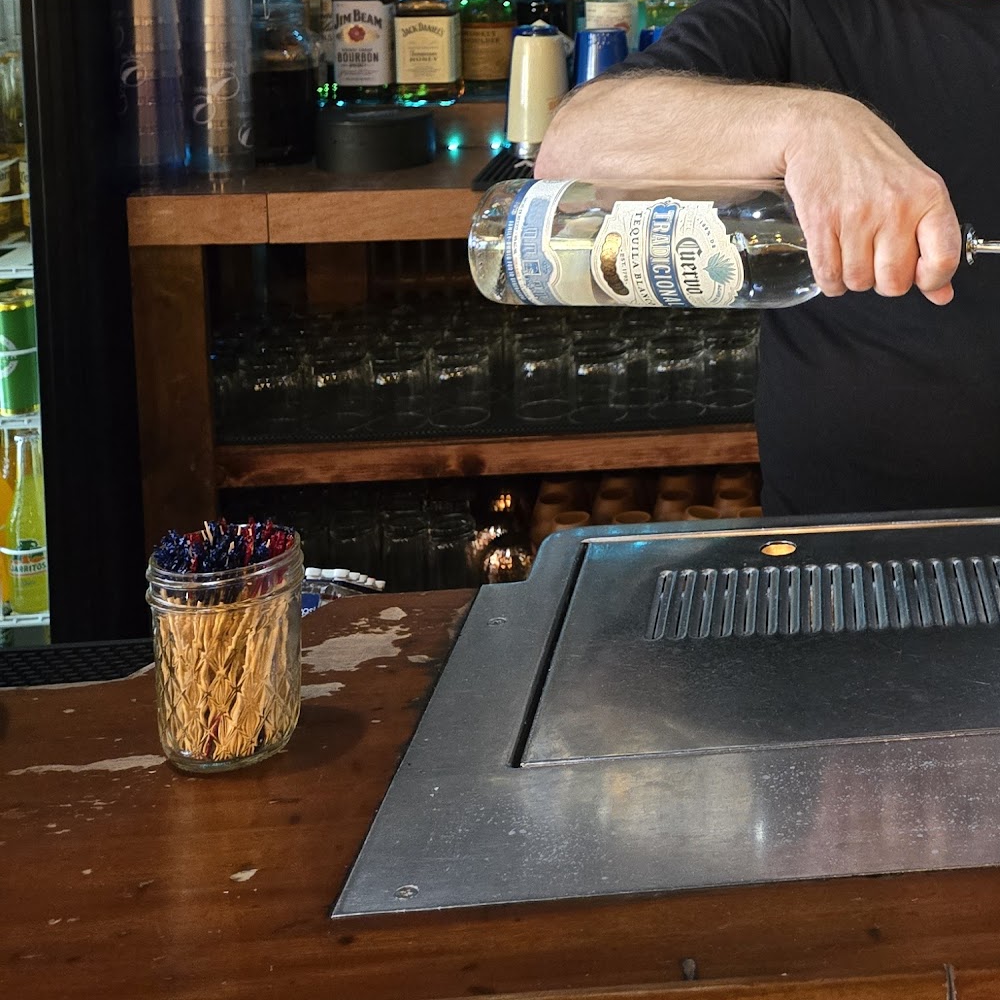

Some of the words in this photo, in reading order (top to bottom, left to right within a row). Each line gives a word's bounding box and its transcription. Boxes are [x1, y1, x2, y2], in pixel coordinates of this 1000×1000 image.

[334, 12, 352, 30] JIM
[352, 9, 383, 29] BEAM
[401, 24, 419, 38] JACK
[337, 52, 379, 63] BOURBON
[629, 210, 643, 270] TEQUILA
[649, 210, 685, 306] TRADICIONAL
[676, 237, 703, 295] Cuervo
